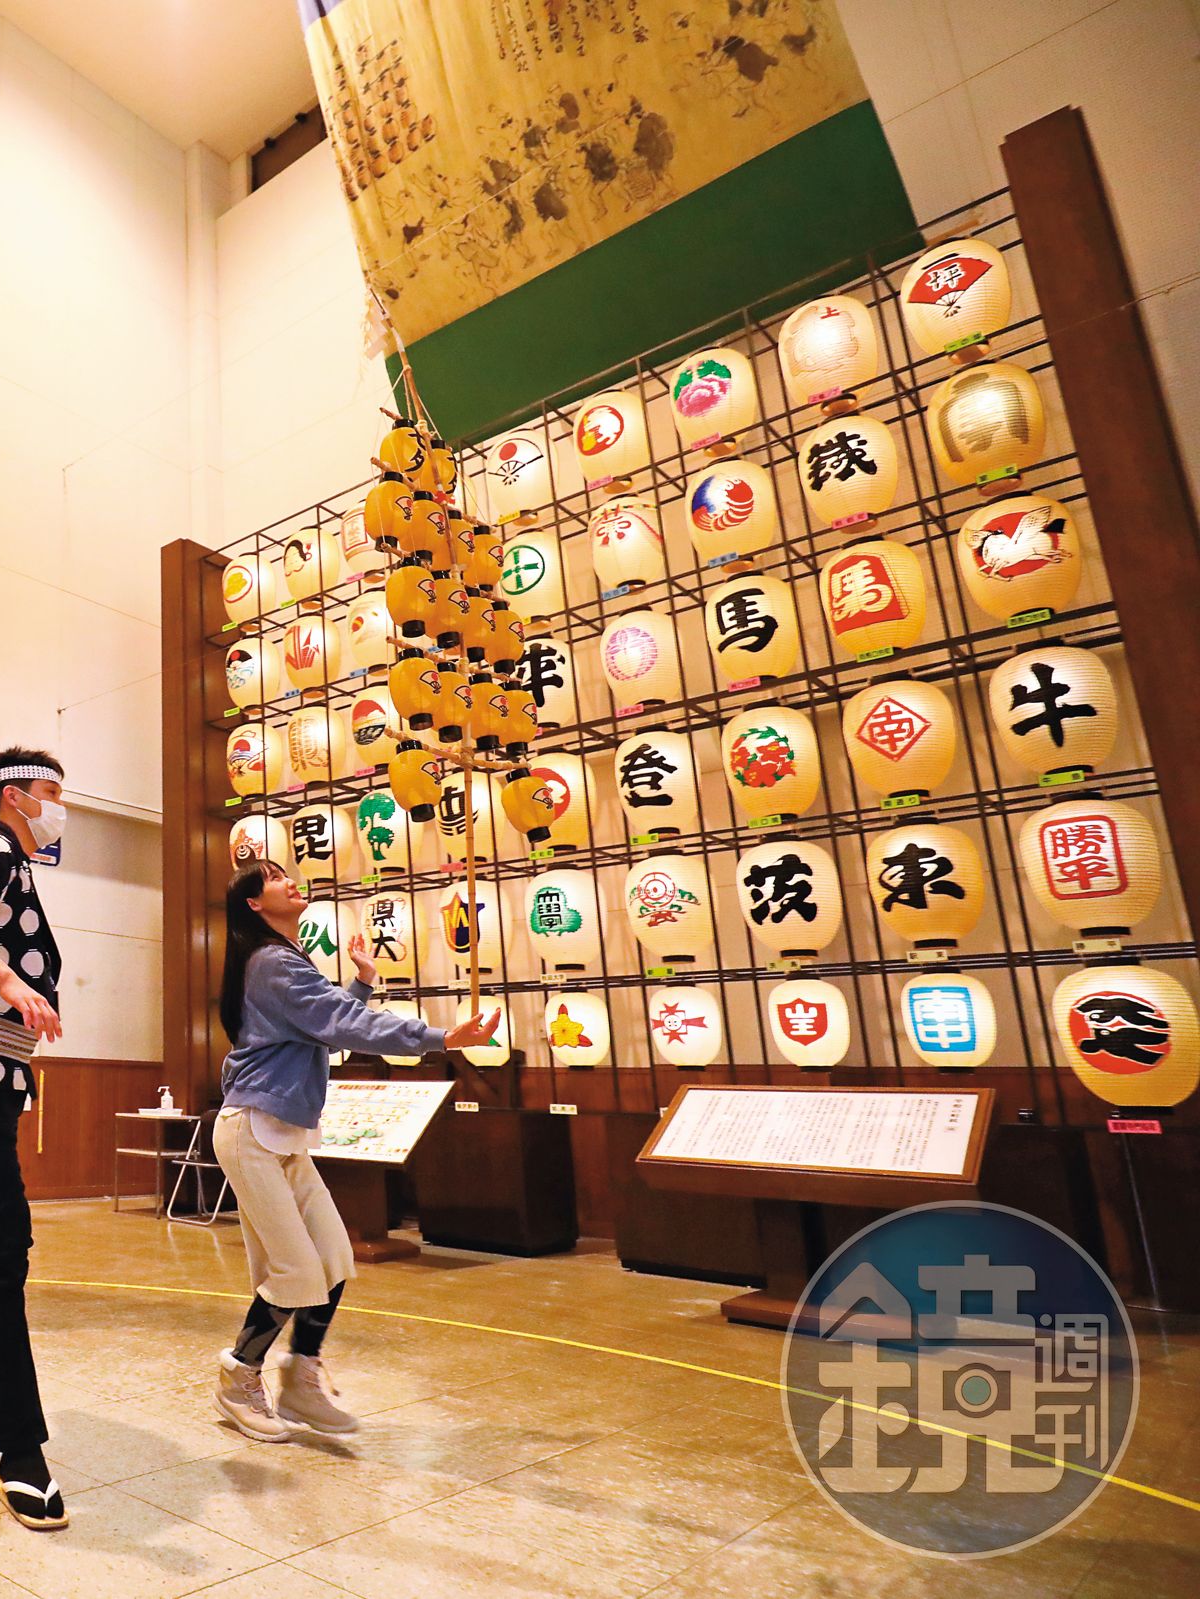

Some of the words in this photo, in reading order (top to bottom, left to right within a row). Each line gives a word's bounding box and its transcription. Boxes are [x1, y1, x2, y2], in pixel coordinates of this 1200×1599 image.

[716, 588, 778, 653] 馬
[832, 560, 892, 621] 馬
[1009, 662, 1097, 747] 牛
[744, 854, 817, 925] 茨
[881, 843, 965, 912] 東
[371, 898, 397, 961] 県大
